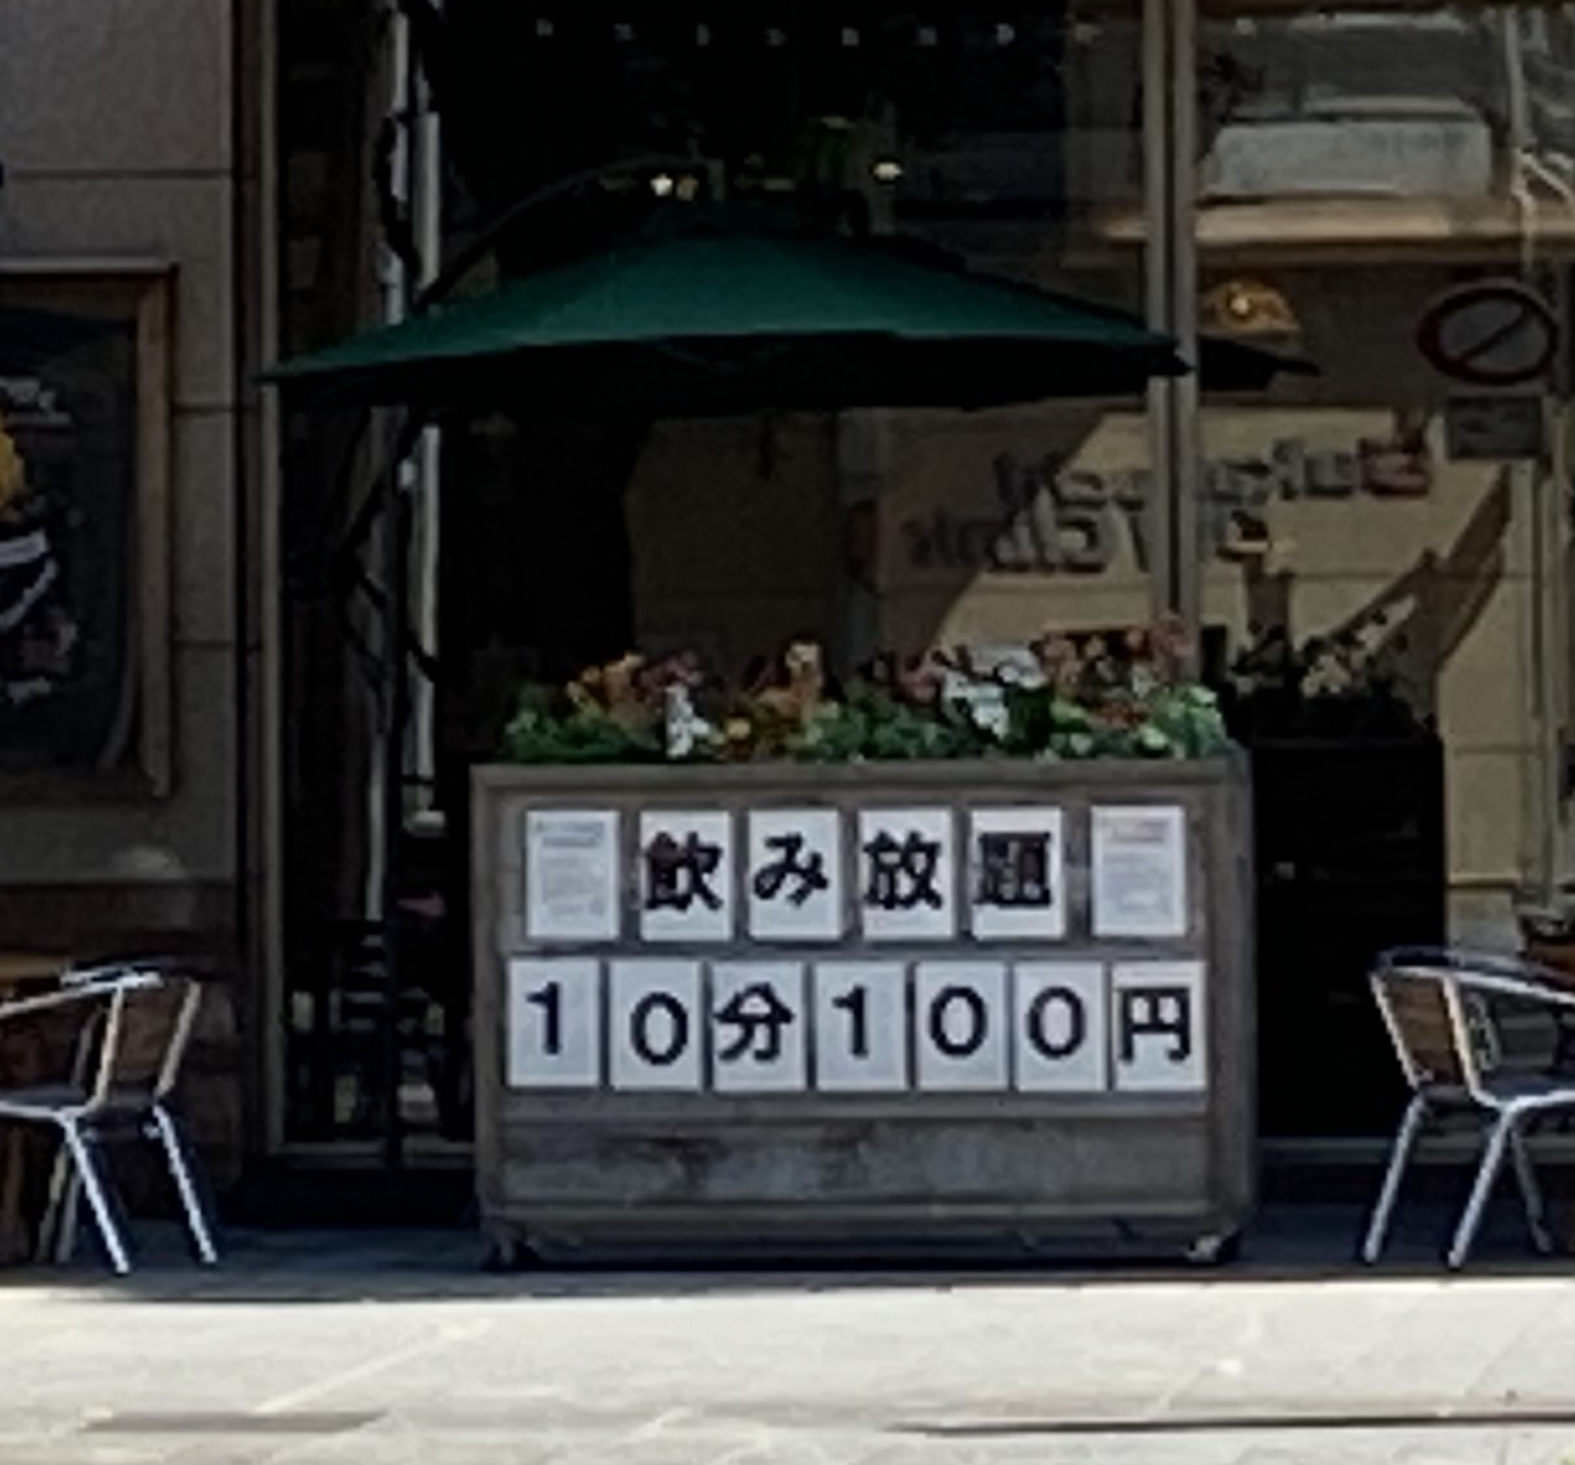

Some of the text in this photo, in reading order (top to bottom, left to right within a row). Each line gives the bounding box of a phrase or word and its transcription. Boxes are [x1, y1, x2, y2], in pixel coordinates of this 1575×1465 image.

[642, 831, 1053, 911] 飲み放題
[526, 981, 1194, 1066] 10分100円
